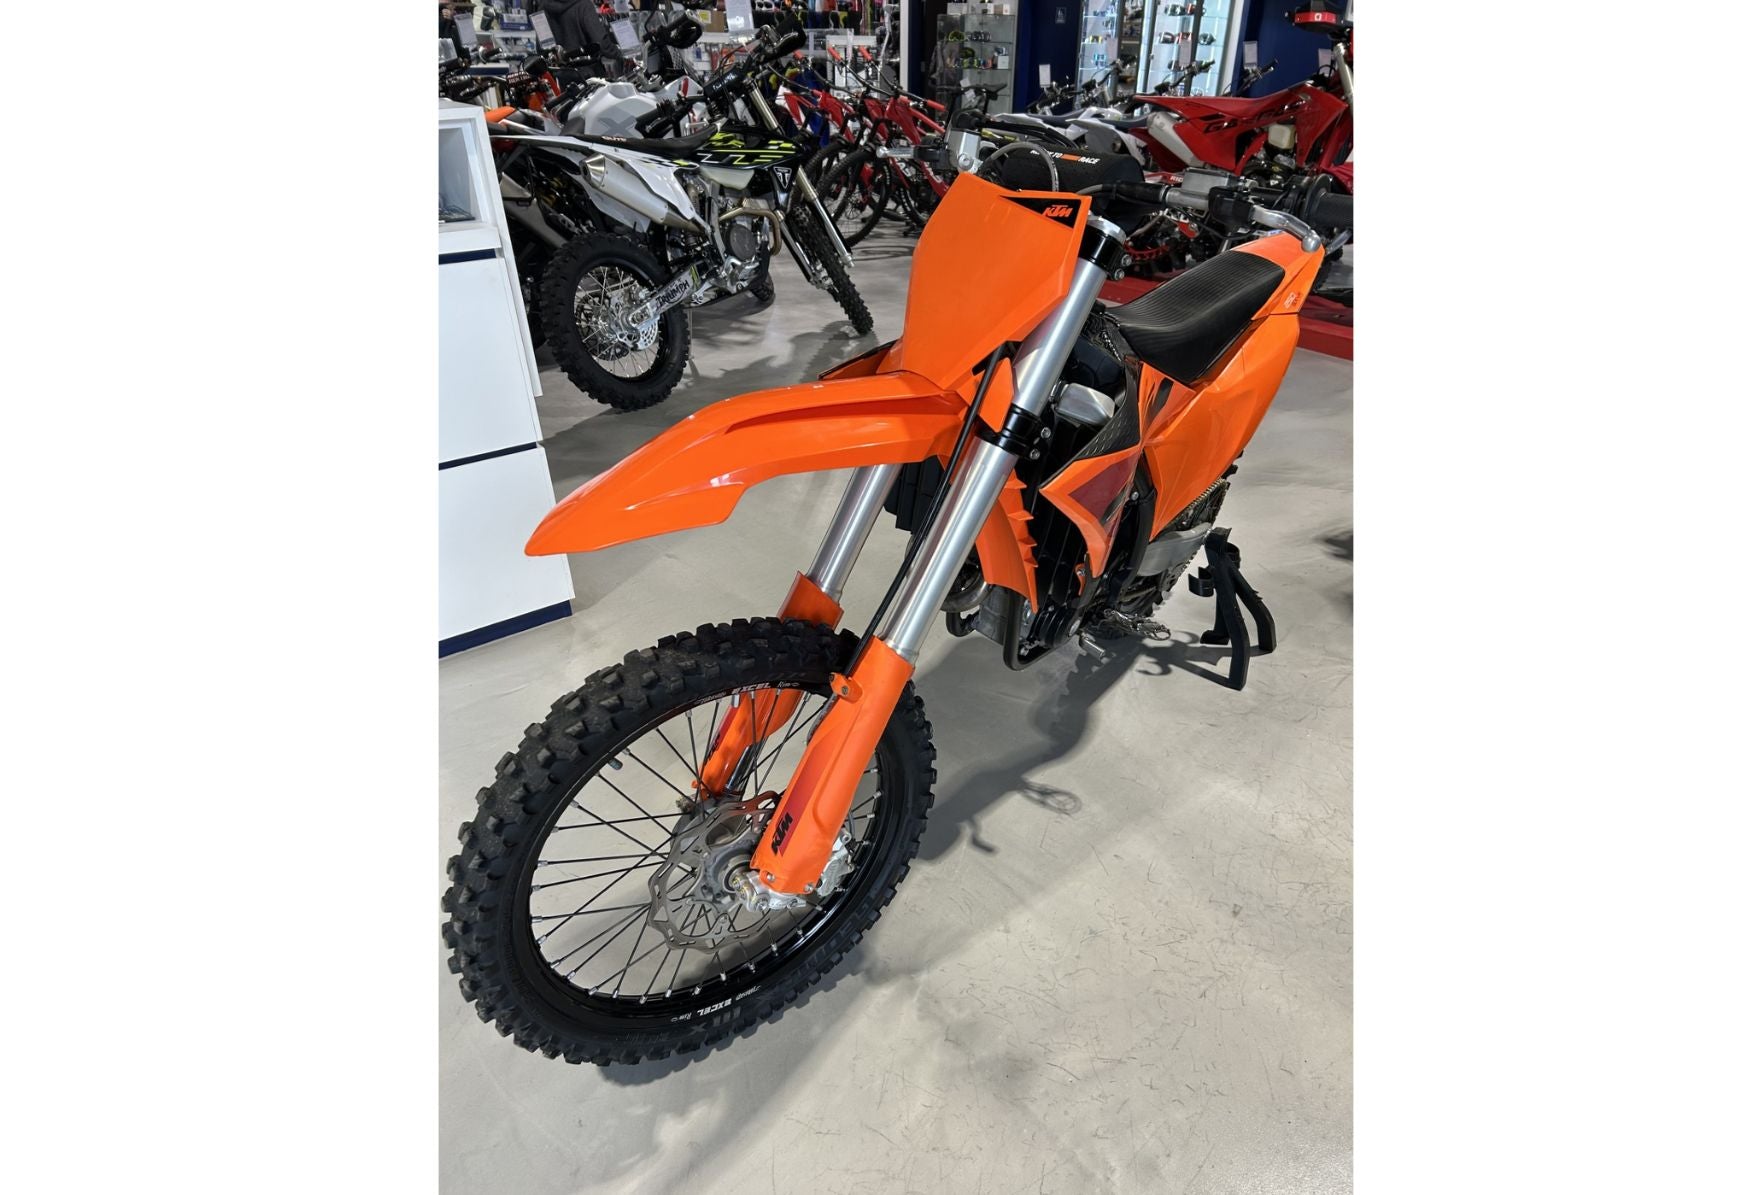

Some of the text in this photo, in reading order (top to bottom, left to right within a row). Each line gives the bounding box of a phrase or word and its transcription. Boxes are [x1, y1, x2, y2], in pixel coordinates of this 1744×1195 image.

[1078, 156, 1101, 165] RACE
[1042, 205, 1073, 218] KTM
[655, 279, 690, 308] TRIUMPH
[731, 682, 772, 694] EXCEL
[771, 811, 794, 857] KTM
[697, 998, 733, 1017] EXCEL
